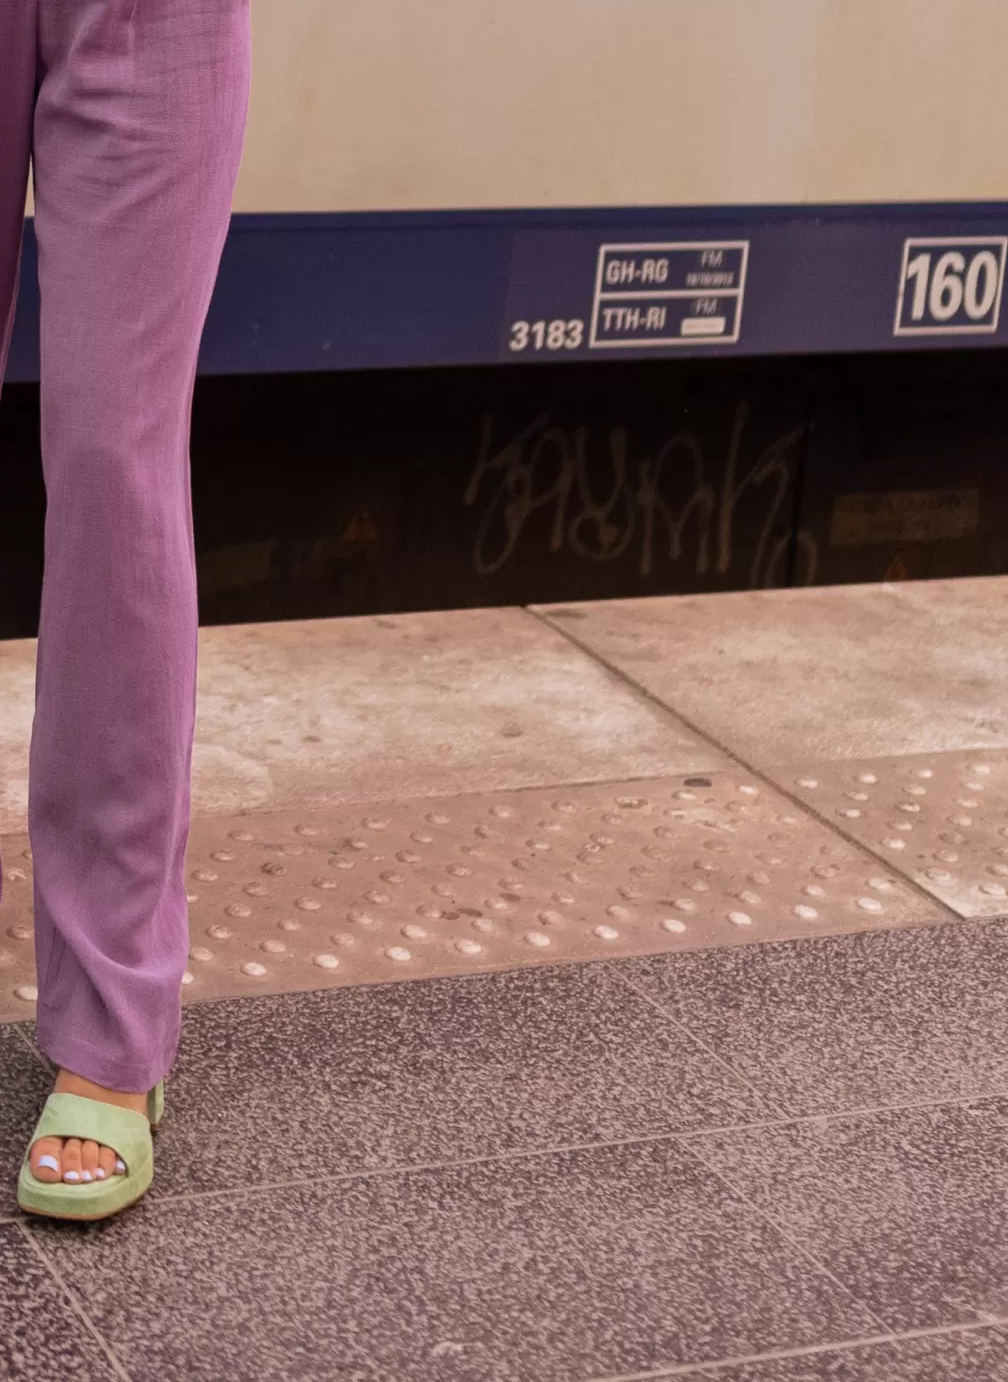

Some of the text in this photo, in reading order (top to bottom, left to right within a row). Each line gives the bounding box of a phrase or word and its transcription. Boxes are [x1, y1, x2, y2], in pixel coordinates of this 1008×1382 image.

[605, 258, 670, 285] GH-RG
[905, 250, 999, 322] 160
[602, 306, 667, 332] TTH-RI
[509, 320, 584, 351] 3183
